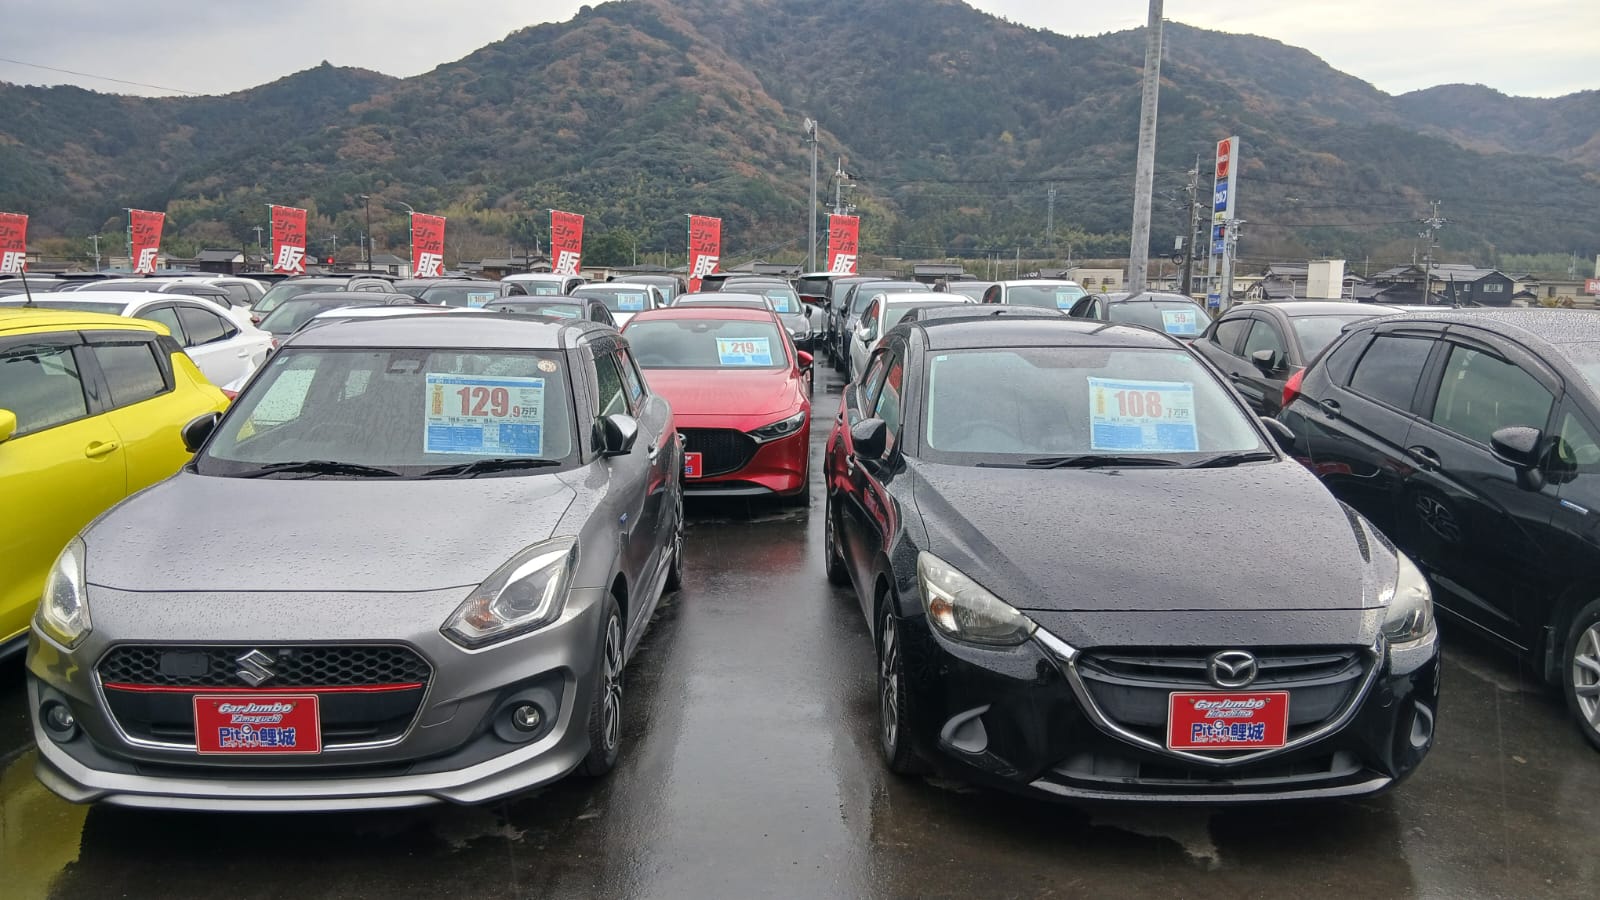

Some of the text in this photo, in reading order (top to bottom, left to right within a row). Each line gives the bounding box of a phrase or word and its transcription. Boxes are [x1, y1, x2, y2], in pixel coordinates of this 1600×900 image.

[134, 247, 159, 273] 販
[273, 245, 305, 272] 販
[414, 252, 443, 277] 販
[553, 250, 581, 276] 販
[219, 703, 292, 714] CarJumbo
[1195, 698, 1265, 709] CarJumbo
